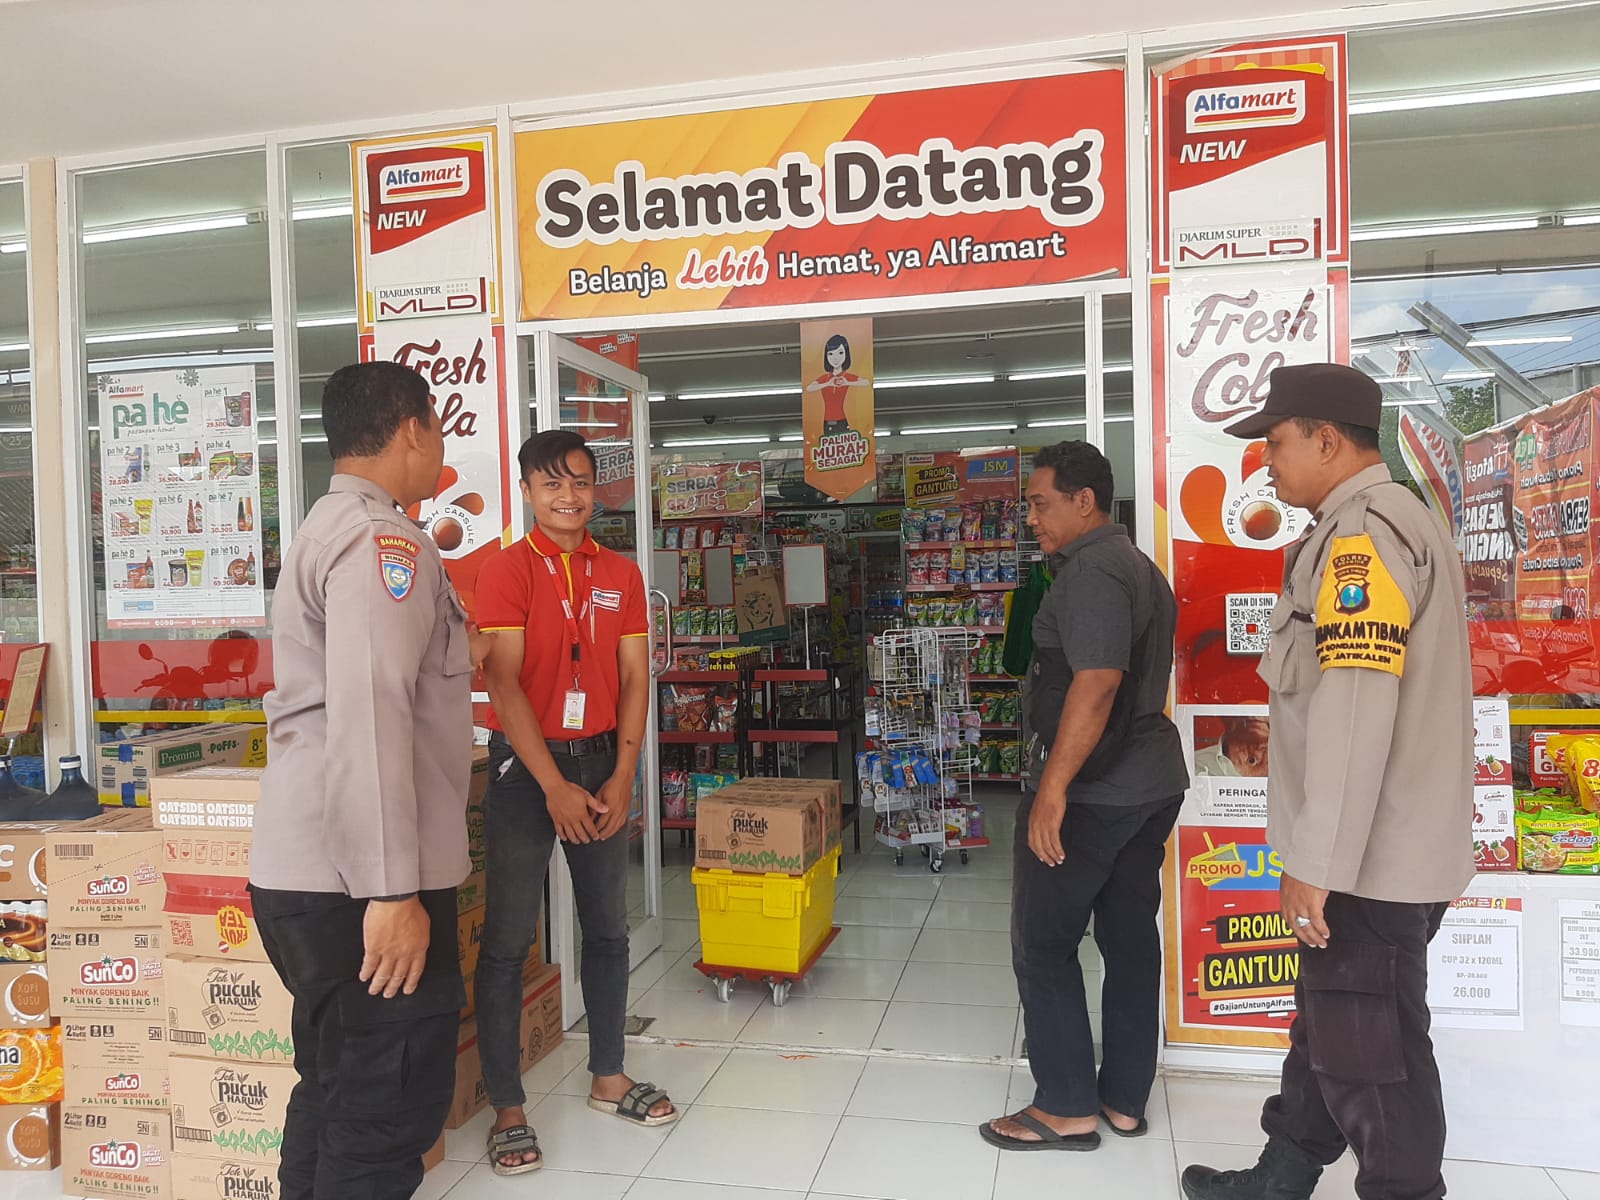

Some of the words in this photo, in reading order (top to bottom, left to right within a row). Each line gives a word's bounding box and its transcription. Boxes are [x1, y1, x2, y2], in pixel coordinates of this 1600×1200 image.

[1194, 88, 1297, 112] Alfamart
[1179, 140, 1247, 164] NEW
[386, 164, 463, 186] Alfamart
[544, 163, 816, 239] Selamat
[834, 141, 1094, 215] Datang
[377, 208, 427, 231] NEW
[1180, 231, 1224, 243] DJARUM
[1227, 228, 1261, 240] SUPER
[1179, 238, 1309, 261] MLD
[571, 263, 667, 298] Belanja
[680, 251, 765, 284] Lebih
[779, 249, 880, 278] Hemat,
[887, 250, 921, 278] ya
[928, 233, 1065, 266] Alfamart
[380, 288, 413, 299] DJARUM
[414, 286, 442, 297] SUPER
[381, 294, 477, 316] MLD
[1176, 288, 1319, 358] Fresh
[109, 385, 143, 394] Alfamart
[223, 387, 228, 396] 1
[1191, 351, 1284, 423] Col
[113, 403, 147, 439] pa
[224, 440, 231, 448] 4
[822, 432, 858, 447] PALING
[125, 446, 131, 455] 2
[174, 443, 180, 452] 3
[813, 441, 866, 461] MURAH
[818, 454, 863, 468] SEJAGAT
[984, 460, 1009, 472] JSM
[596, 464, 635, 486] RATIS
[924, 467, 950, 478] PROMO
[667, 476, 718, 493] SERBA
[917, 481, 958, 495] GANTUNG
[128, 497, 133, 506] 5
[177, 493, 182, 503] 6
[227, 492, 233, 501] 7
[1226, 492, 1250, 535] FRESH
[129, 549, 135, 558] 8
[179, 547, 185, 556] 9
[229, 545, 240, 555] 10
[1230, 598, 1250, 607] SCAN
[1250, 598, 1257, 607] DI
[1258, 597, 1273, 606] SINI
[1334, 653, 1391, 664] JATIKALEN
[161, 750, 201, 765] Promina
[1219, 788, 1267, 798] PERINGA
[159, 802, 204, 815] OATSIDE
[207, 802, 254, 815] OATSIDE
[159, 814, 205, 826] OATSIDE
[207, 815, 253, 827] OATSIDE
[734, 817, 768, 832] pucuk
[1191, 864, 1241, 875] PROMO
[89, 879, 126, 895] SunCo
[219, 910, 247, 929] TEA
[51, 934, 57, 946] 2
[83, 961, 133, 983] SunCo
[71, 988, 98, 997] MINYAK
[100, 989, 130, 997] GORENG
[132, 989, 149, 997] BAIK
[210, 980, 262, 1004] pucuk
[1453, 986, 1491, 998] 26.000
[63, 996, 102, 1005] PALING
[219, 997, 257, 1006] HARUM
[66, 1025, 72, 1038] 2
[107, 1075, 138, 1089] SunCo
[218, 1081, 268, 1102] pucuk
[82, 1097, 117, 1105] PALING
[227, 1095, 264, 1105] HARUM
[64, 1113, 70, 1125] 2
[91, 1145, 137, 1167] SunCo
[73, 1177, 108, 1188] PALING
[80, 1169, 104, 1179] MINYAK
[104, 1171, 132, 1182] GORENG
[133, 1173, 150, 1183] BAIK
[224, 1176, 274, 1197] pucuk
